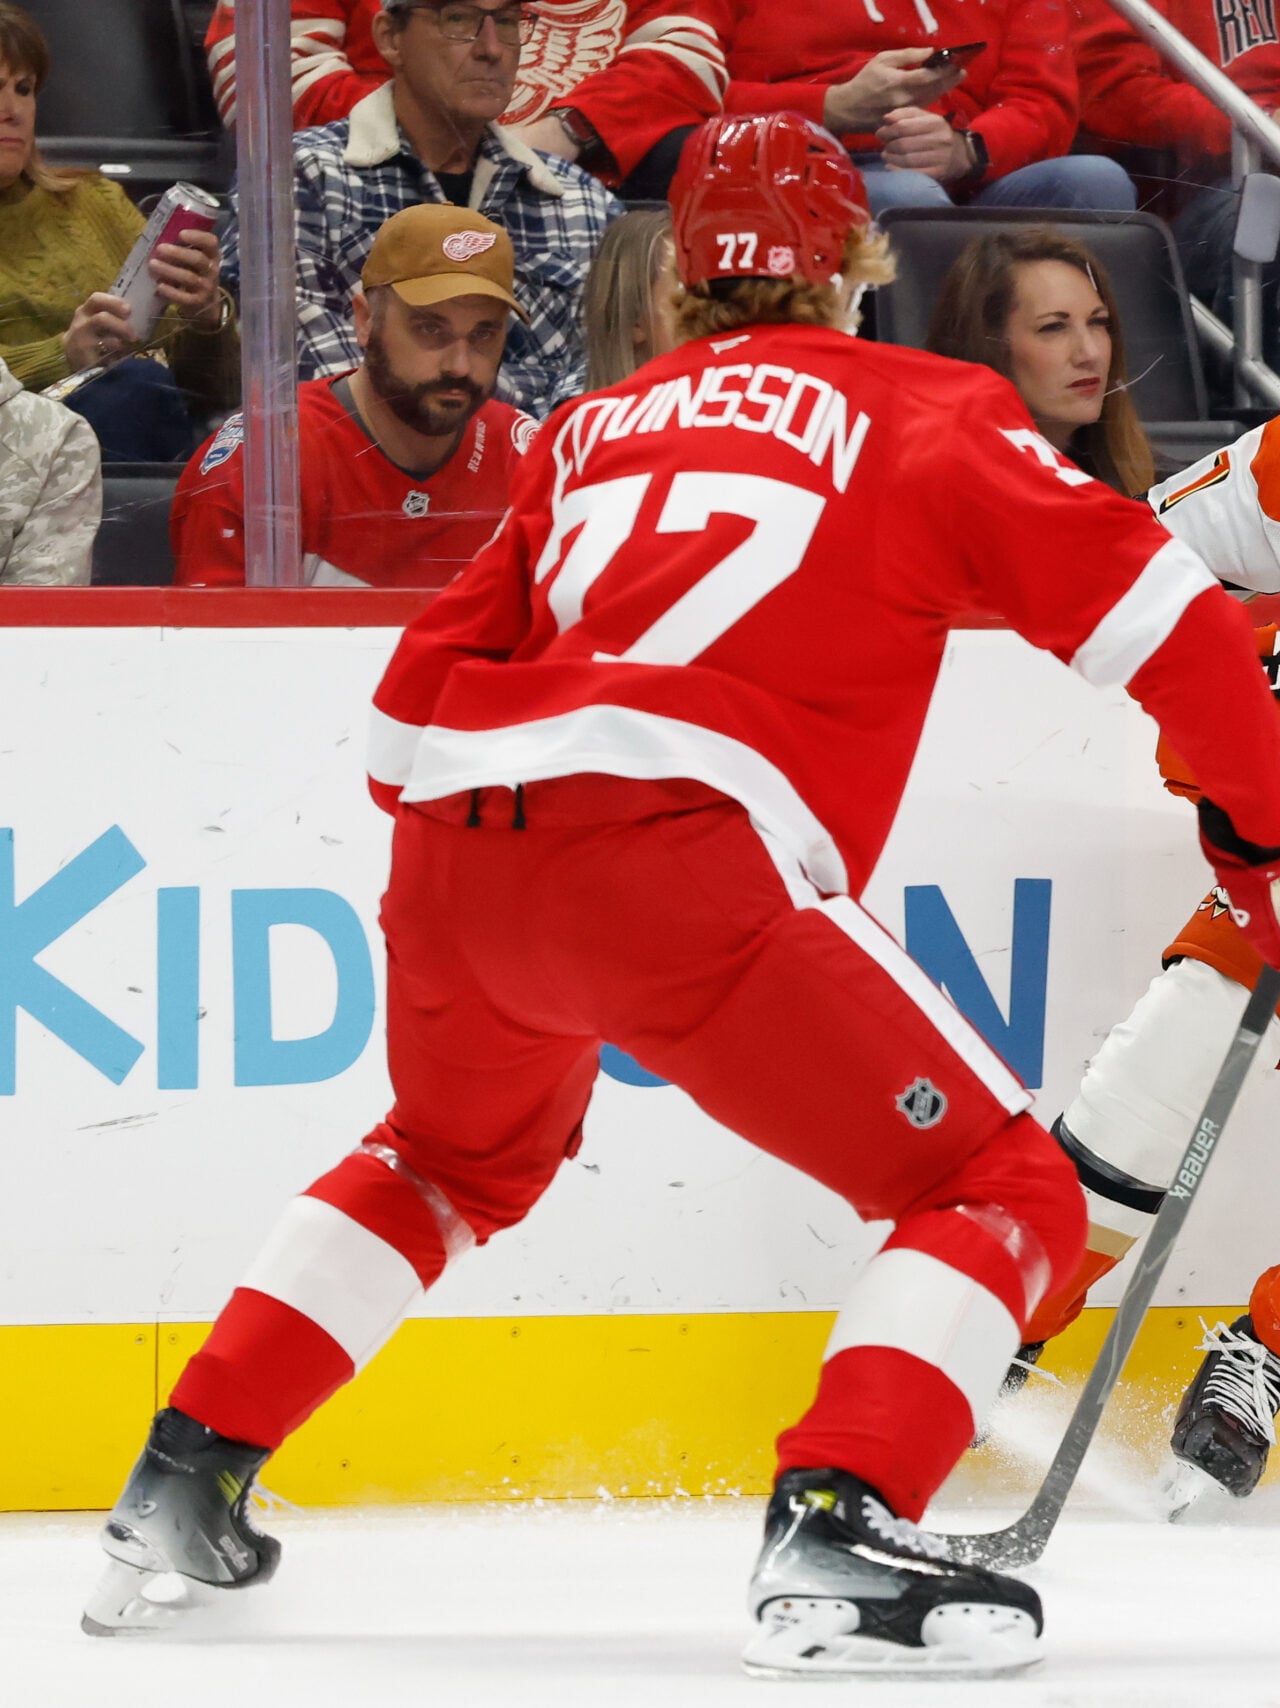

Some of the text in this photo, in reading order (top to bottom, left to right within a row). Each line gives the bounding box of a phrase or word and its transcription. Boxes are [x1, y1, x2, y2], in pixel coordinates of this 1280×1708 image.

[716, 232, 758, 270] 77
[534, 471, 827, 667] 77
[1179, 1117, 1220, 1189] BAUER
